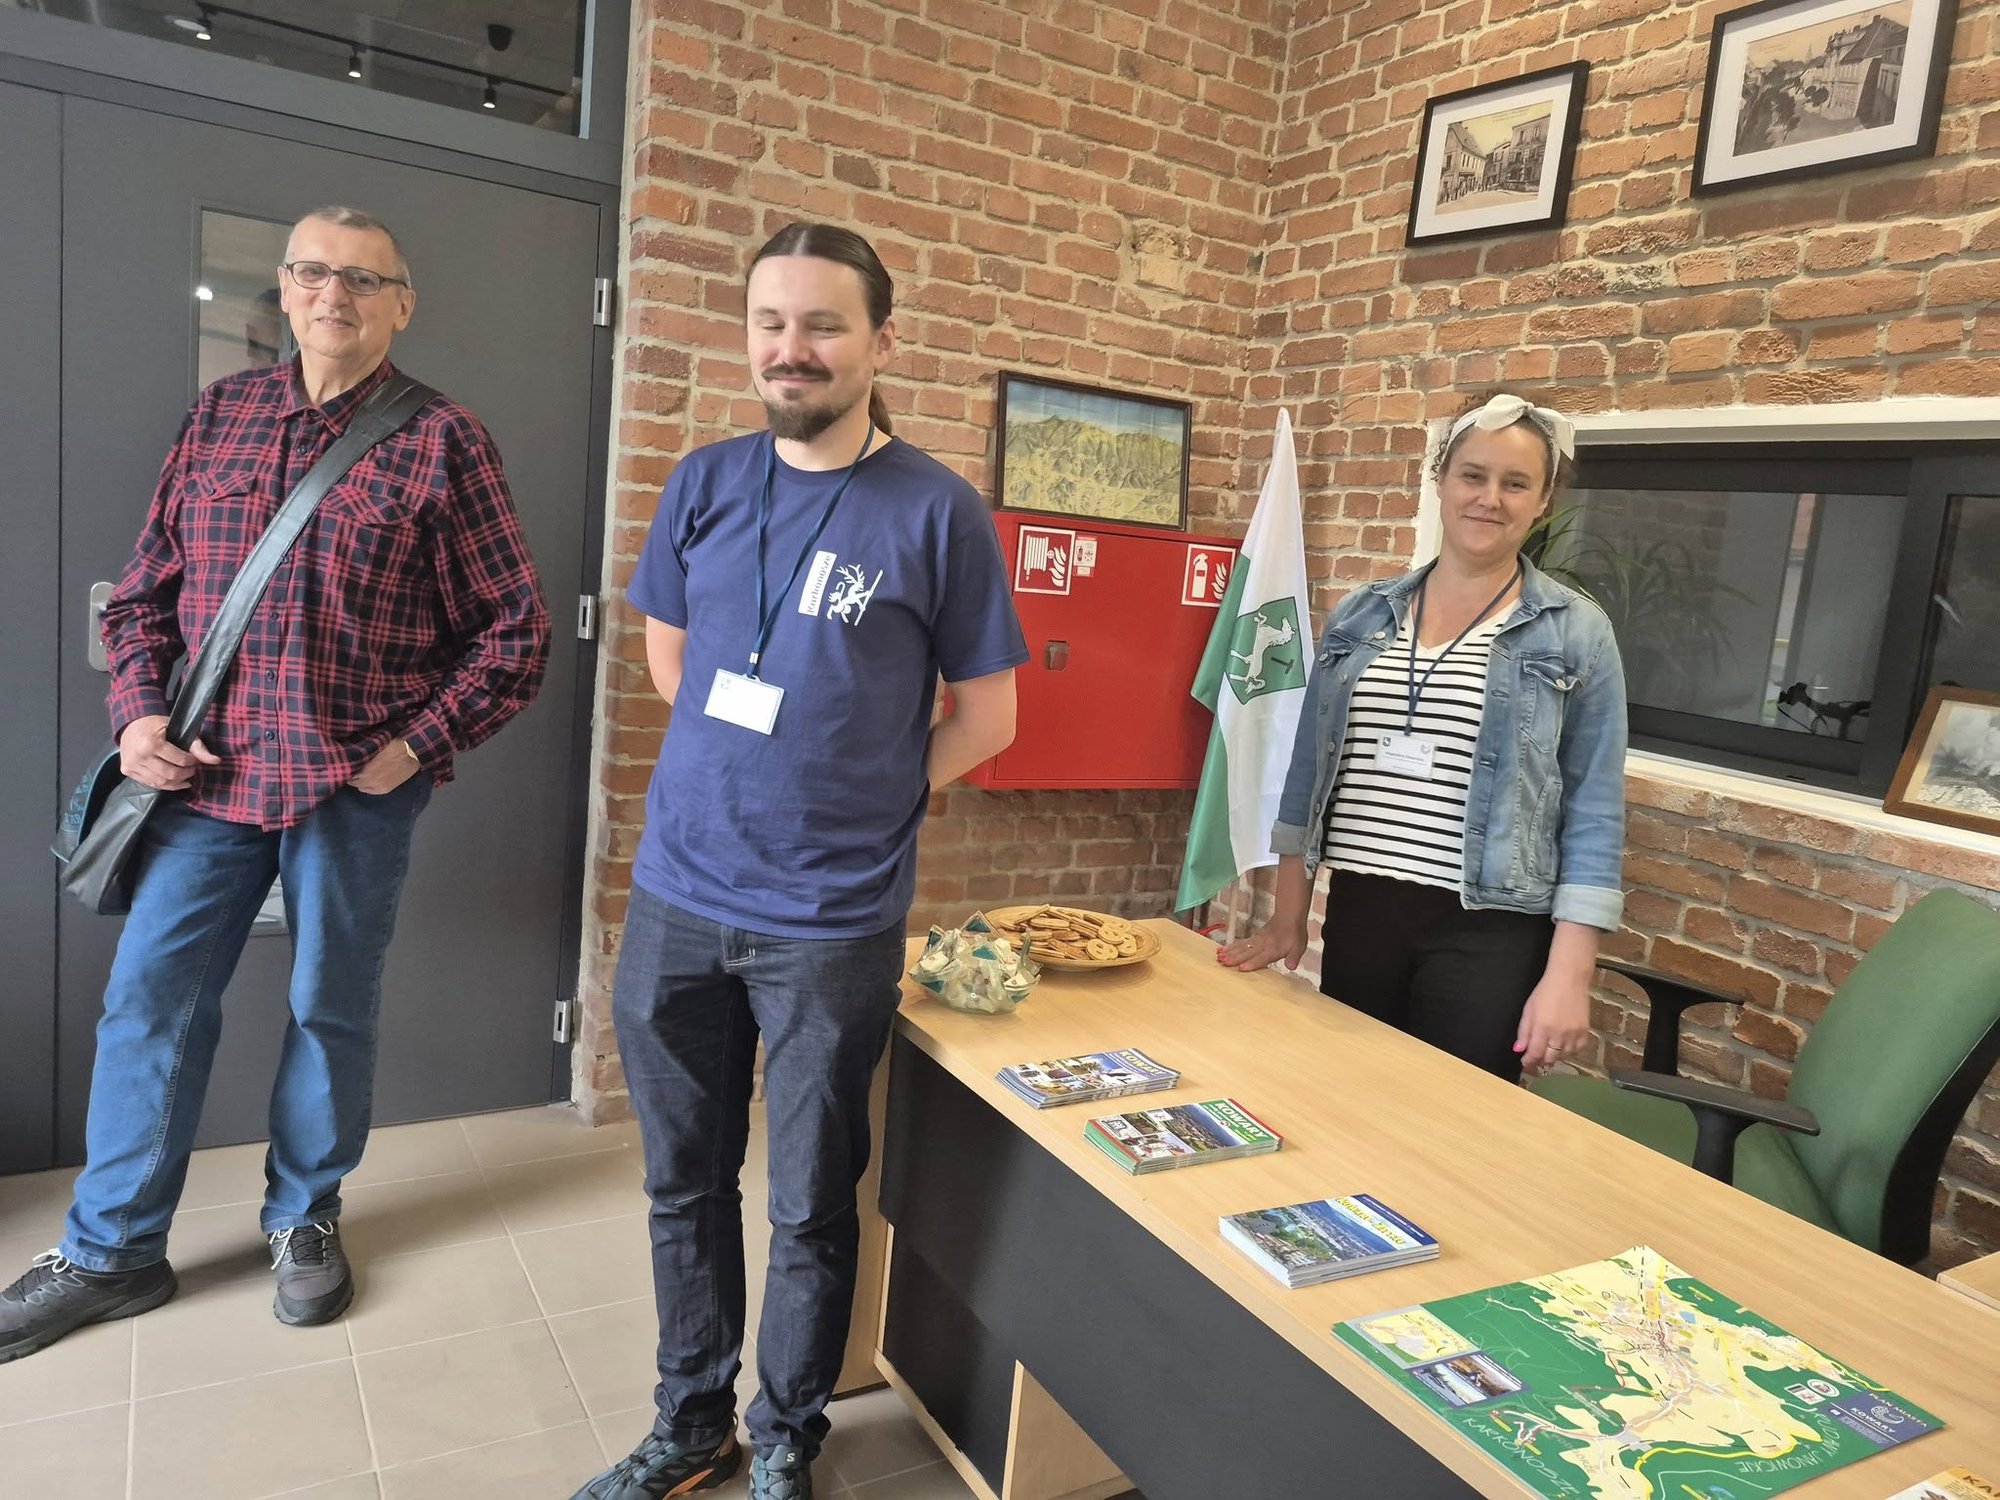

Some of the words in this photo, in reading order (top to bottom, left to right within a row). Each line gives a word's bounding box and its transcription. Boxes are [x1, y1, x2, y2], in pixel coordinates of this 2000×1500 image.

[1214, 1102, 1269, 1139] KOWARY
[1850, 1407, 1896, 1434] KOWARY
[1868, 1393, 1894, 1407] PLAN
[1893, 1405, 1928, 1428] MIASTA
[1462, 1417, 1580, 1495] KARKONOSZE
